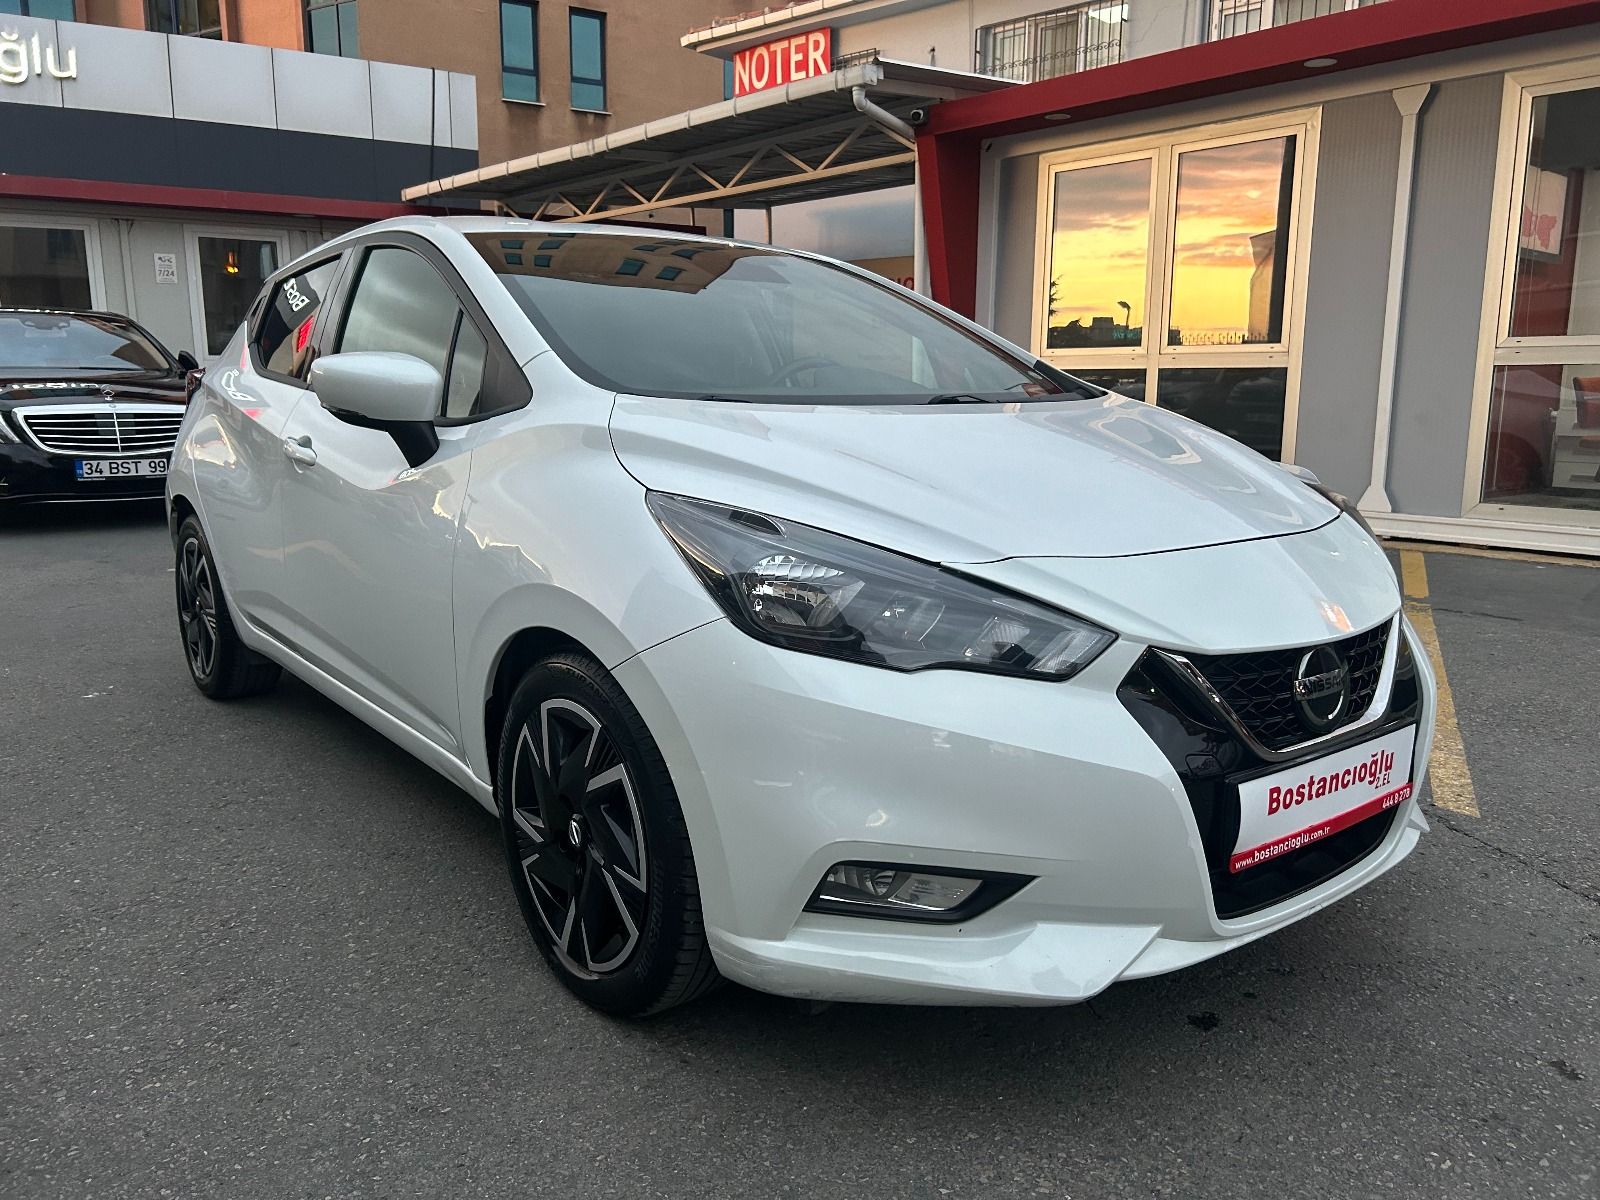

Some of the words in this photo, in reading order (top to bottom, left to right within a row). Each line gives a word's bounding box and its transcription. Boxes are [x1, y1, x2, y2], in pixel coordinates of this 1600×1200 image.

[735, 32, 828, 95] NOTER
[158, 269, 175, 277] 7/24
[84, 462, 103, 475] 34
[109, 461, 141, 474] BST
[148, 460, 166, 473] 99
[1267, 750, 1394, 816] Bostancıoğlu
[1375, 771, 1390, 789] 2.EL
[1382, 796, 1394, 808] 444
